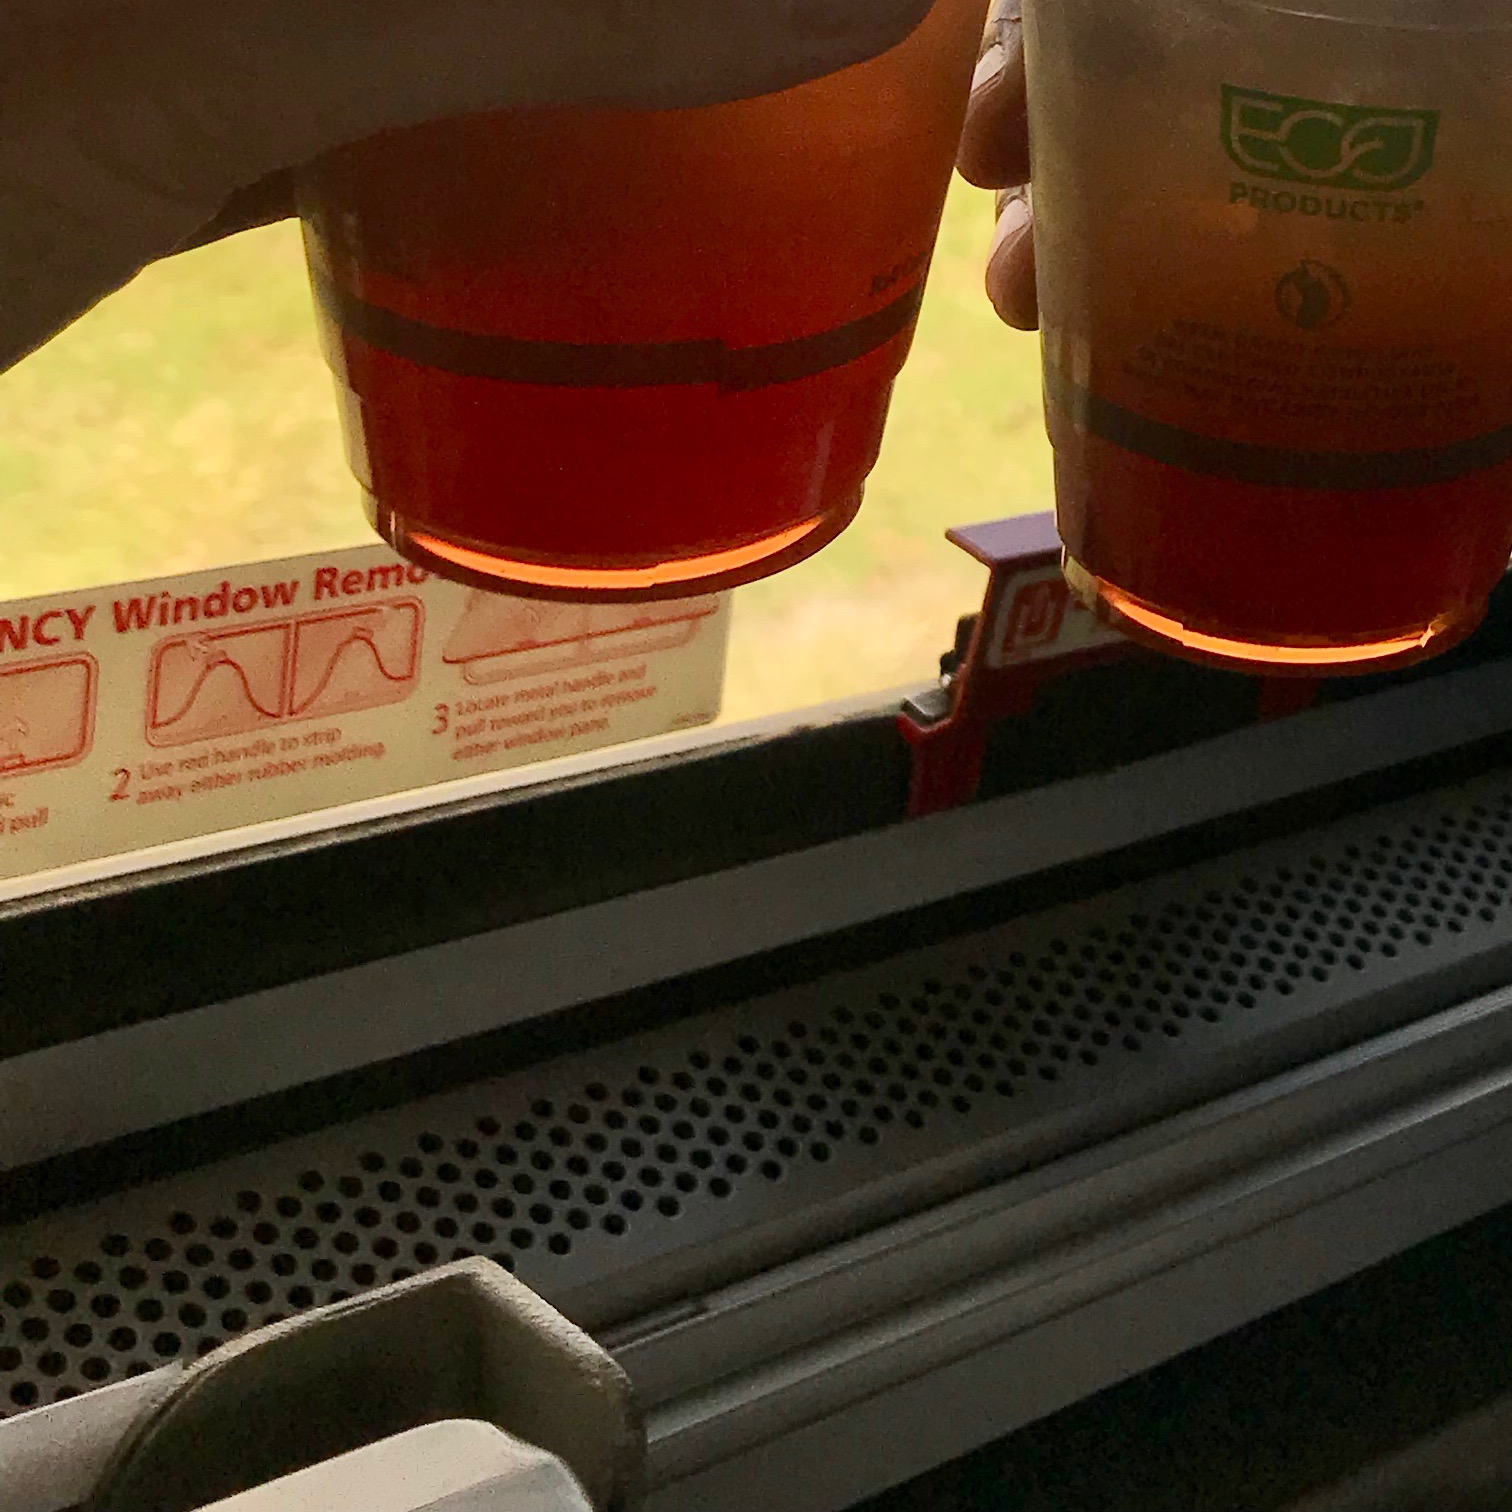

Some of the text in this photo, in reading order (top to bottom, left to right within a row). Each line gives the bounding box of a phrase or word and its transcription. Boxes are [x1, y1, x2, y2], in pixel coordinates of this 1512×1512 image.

[1229, 181, 1412, 224] PRODUCTS
[0, 561, 430, 654] NCY Window Remo
[431, 702, 450, 736] 3
[618, 662, 648, 683] and
[455, 717, 487, 740] pull
[580, 697, 600, 713] to
[108, 726, 342, 802] 2 Use red handle to strip
[247, 757, 307, 782] rubber
